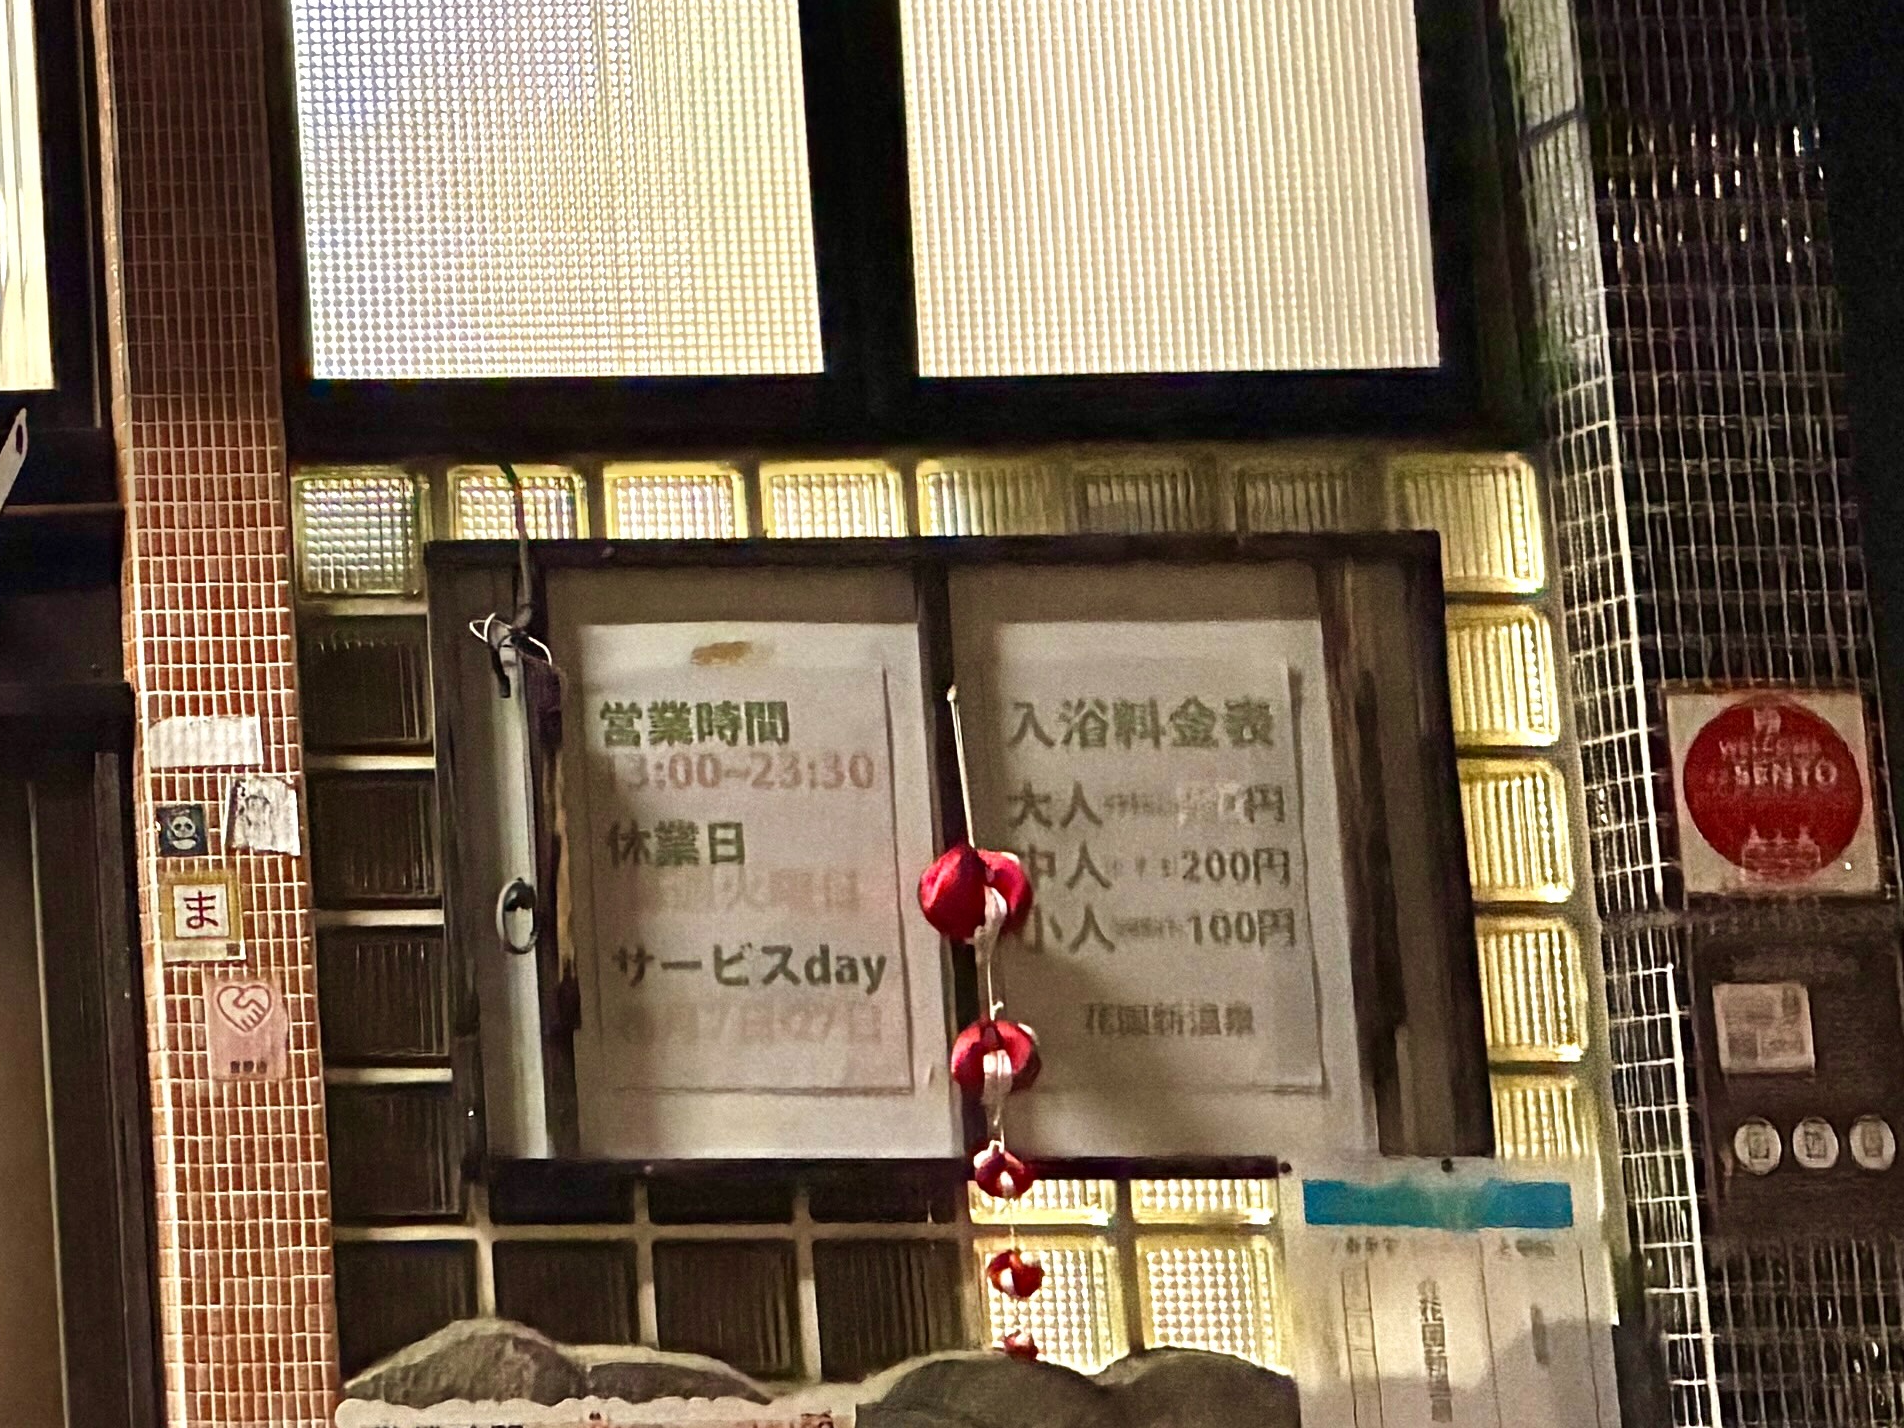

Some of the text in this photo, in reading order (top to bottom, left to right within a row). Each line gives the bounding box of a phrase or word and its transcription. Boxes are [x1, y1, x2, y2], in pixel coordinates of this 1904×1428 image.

[599, 701, 789, 747] 営業時間
[1008, 697, 1274, 749] 入浴料金表
[1008, 780, 1103, 828] 大人
[608, 821, 746, 866] 休業日
[1182, 847, 1290, 888] 200円
[183, 890, 219, 930] ま
[1191, 909, 1295, 948] 100円
[612, 943, 887, 995] サービスday
